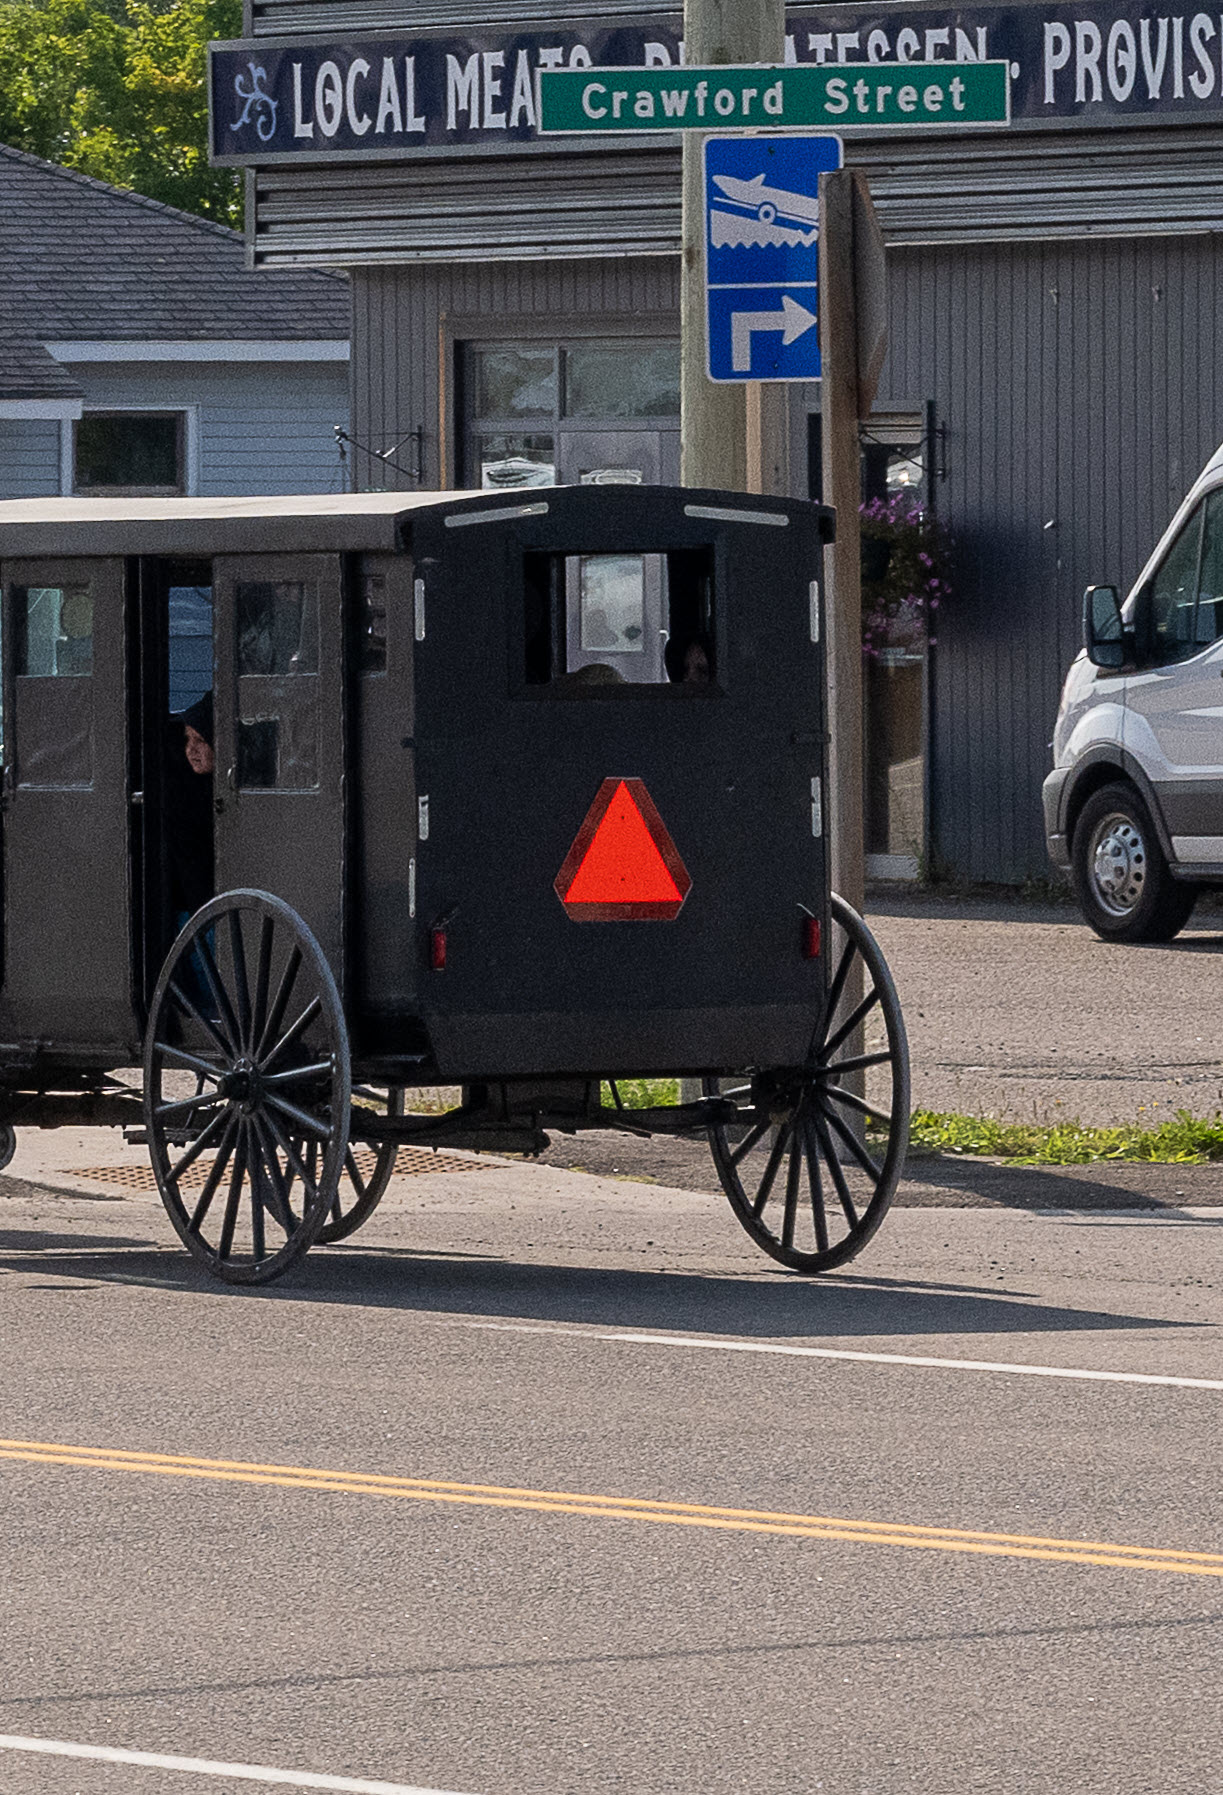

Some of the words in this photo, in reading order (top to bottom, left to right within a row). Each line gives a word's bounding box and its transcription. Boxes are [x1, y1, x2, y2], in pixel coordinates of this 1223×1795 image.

[292, 57, 425, 138] LOCAL
[446, 44, 593, 131] MEA
[1043, 13, 1223, 104] PROVIS
[582, 81, 784, 118] Crawford
[824, 77, 966, 114] Street
